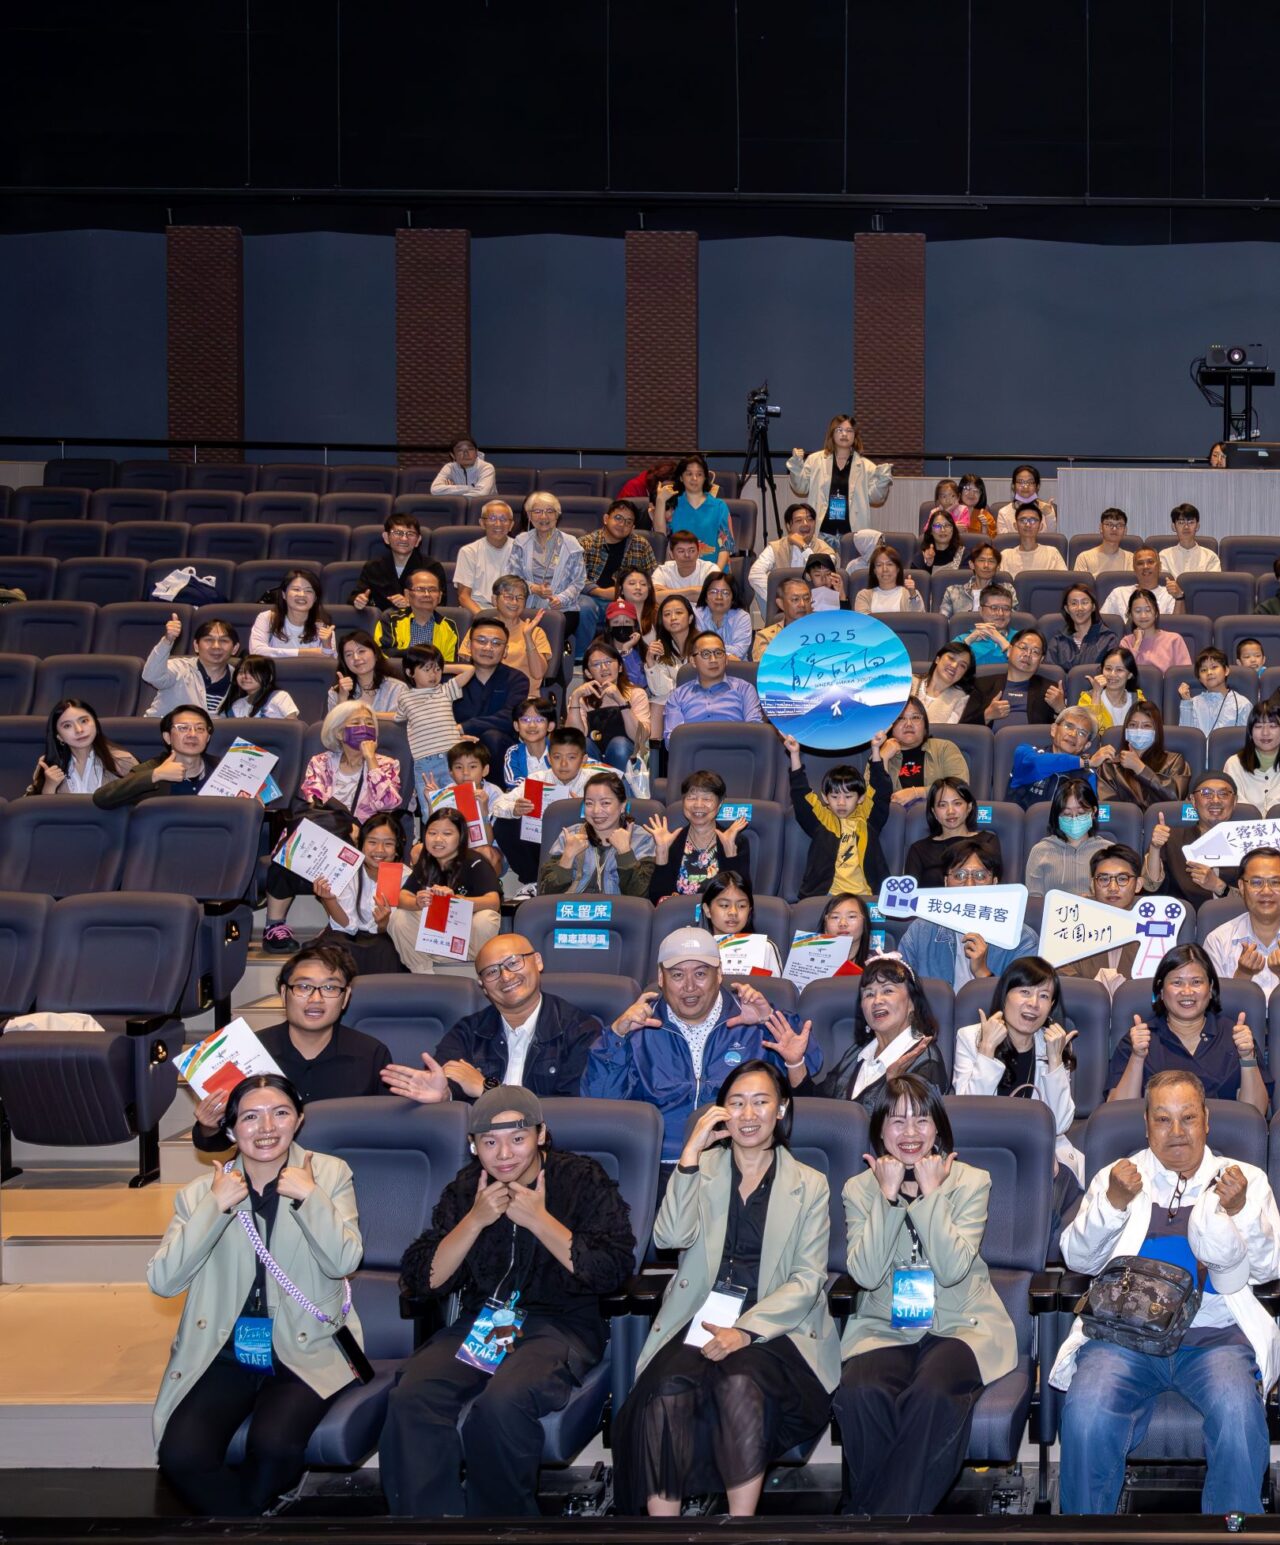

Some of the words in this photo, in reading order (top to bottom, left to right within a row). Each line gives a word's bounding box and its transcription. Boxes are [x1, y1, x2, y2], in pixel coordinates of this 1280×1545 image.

[801, 629, 856, 646] 2025
[722, 805, 749, 819] 留席
[561, 904, 608, 918] 保留席
[927, 898, 1009, 923] 我94是青客
[896, 1304, 929, 1318] STAFF
[468, 1341, 498, 1362] STAFF
[239, 1352, 268, 1366] STAFF
